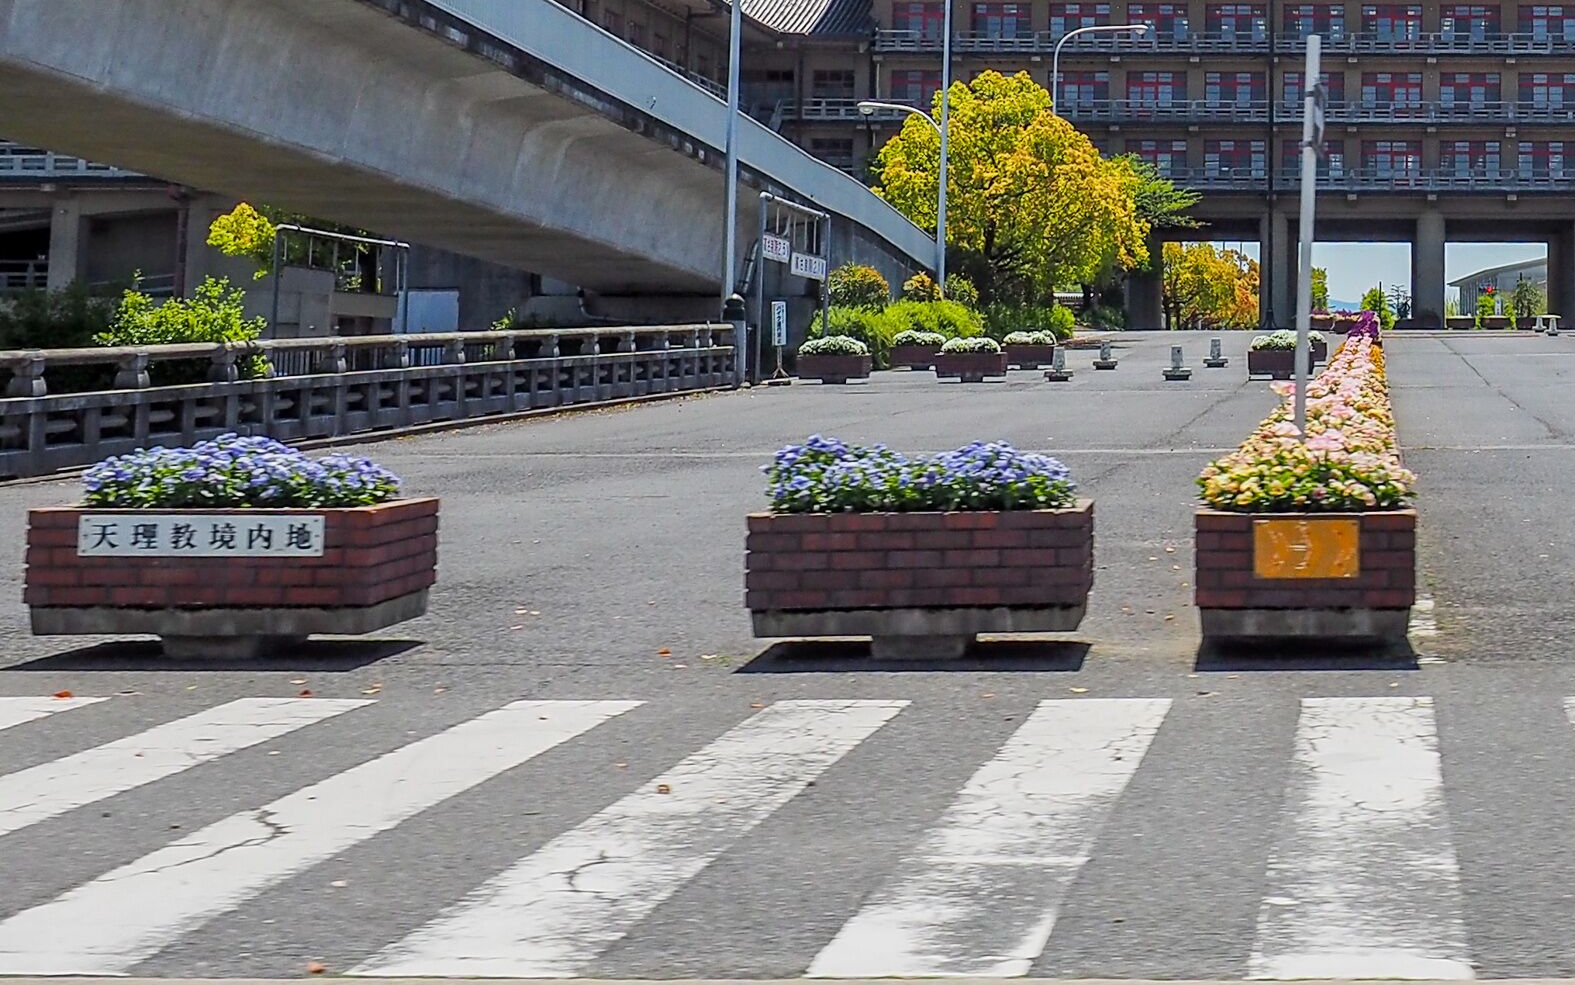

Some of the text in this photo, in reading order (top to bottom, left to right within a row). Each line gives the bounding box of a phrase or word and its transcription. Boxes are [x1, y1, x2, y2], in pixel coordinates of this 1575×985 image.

[90, 523, 313, 550] 天理教境内地
